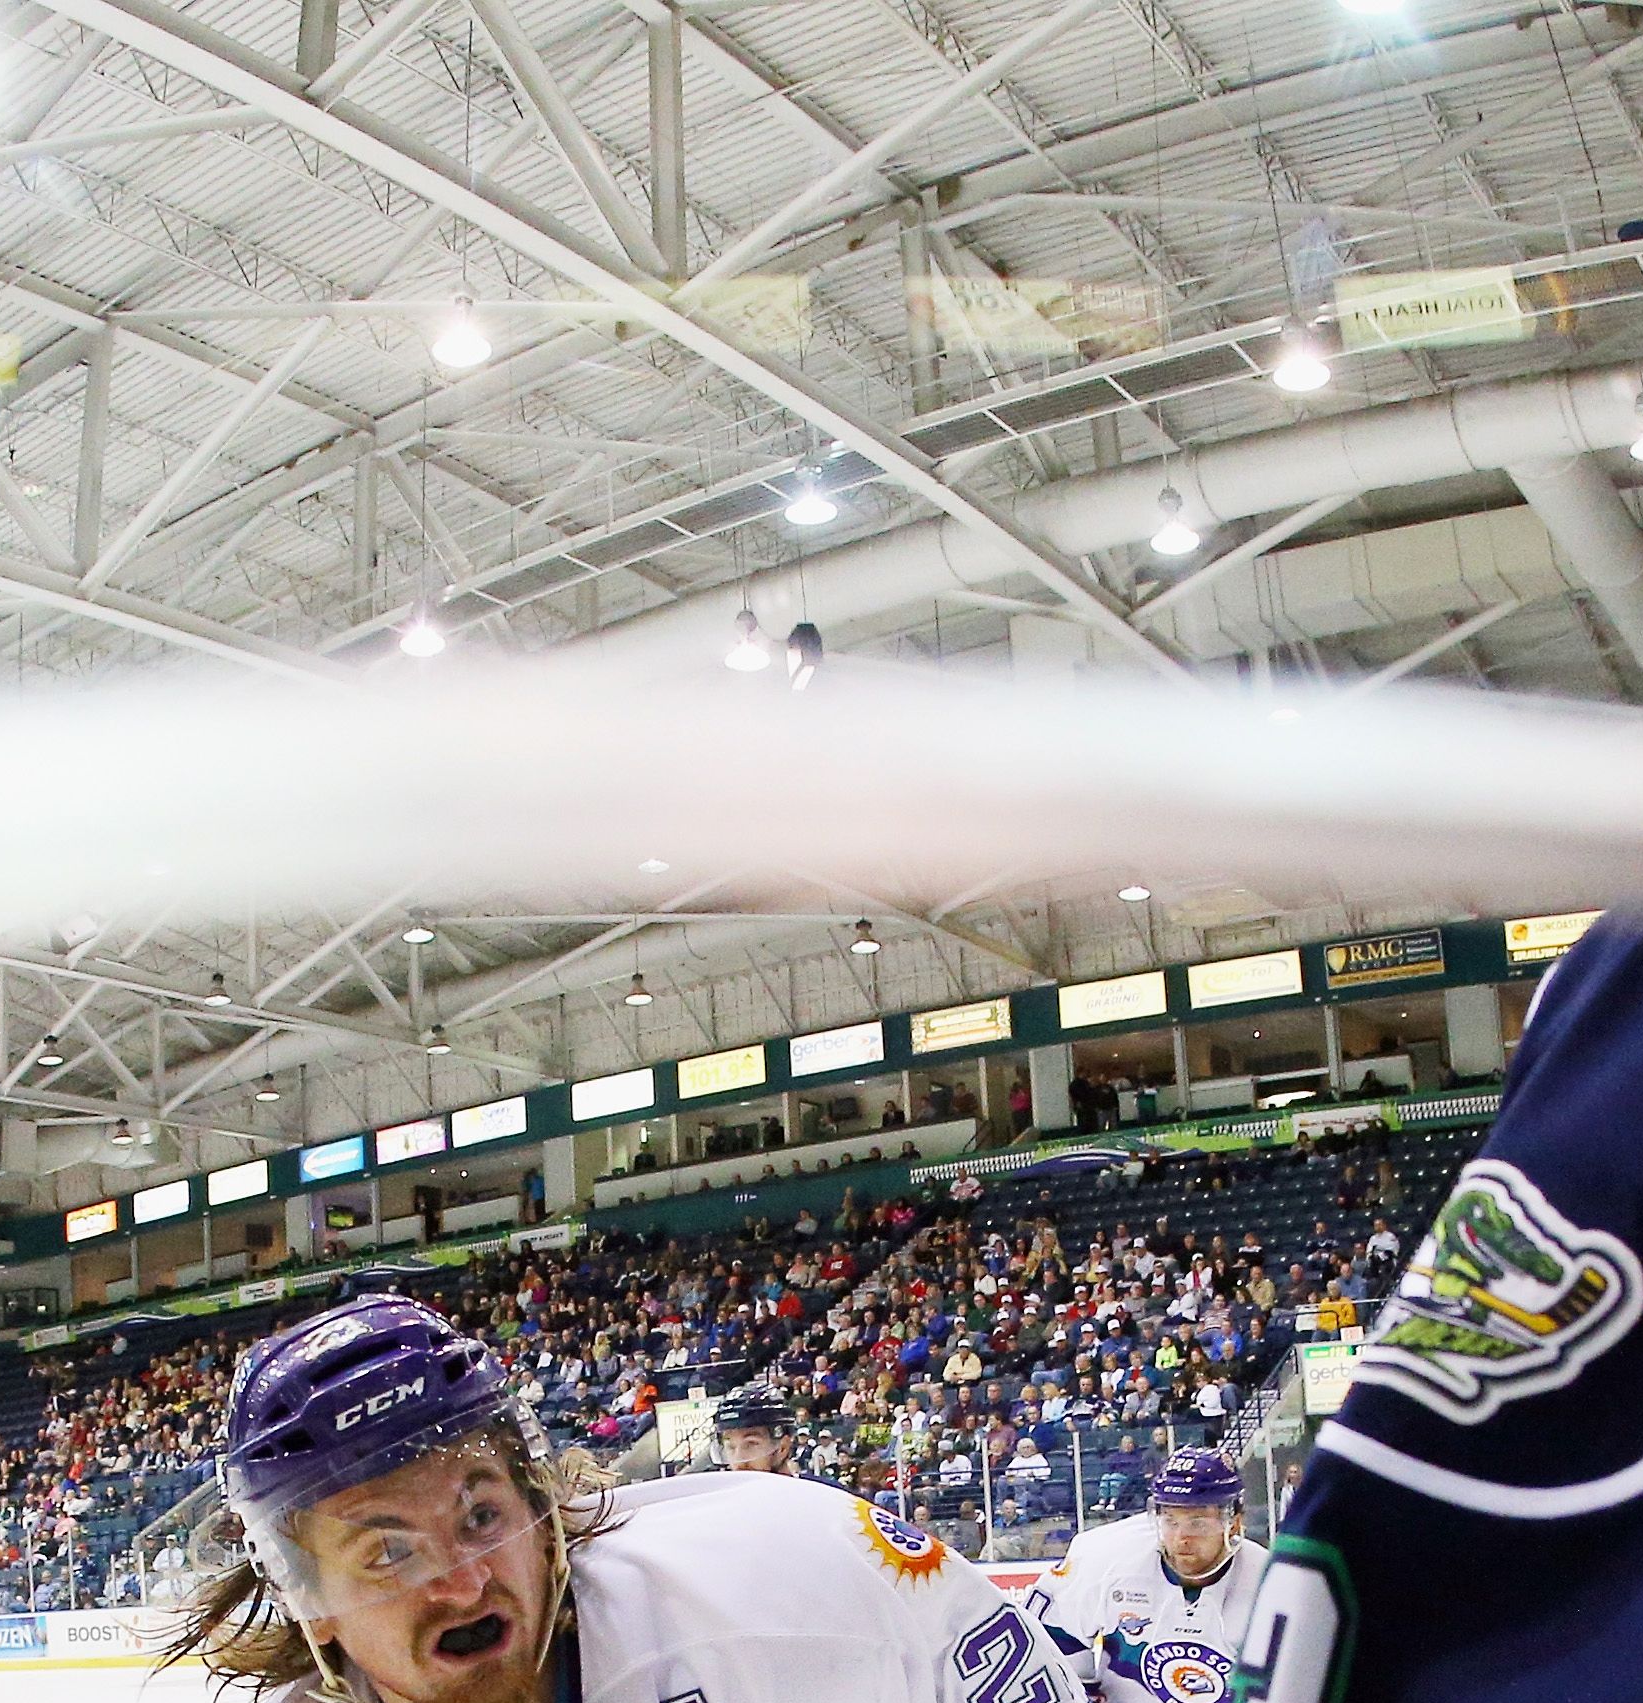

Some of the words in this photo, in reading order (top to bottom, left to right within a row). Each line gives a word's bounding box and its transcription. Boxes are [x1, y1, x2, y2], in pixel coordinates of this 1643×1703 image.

[791, 1033, 854, 1062] gerber
[1309, 1361, 1356, 1385] gerb
[335, 1376, 425, 1431] CCM
[1163, 1485, 1192, 1494] CCM
[68, 1625, 121, 1642] BOOST
[1145, 1645, 1202, 1690] ORLANDO
